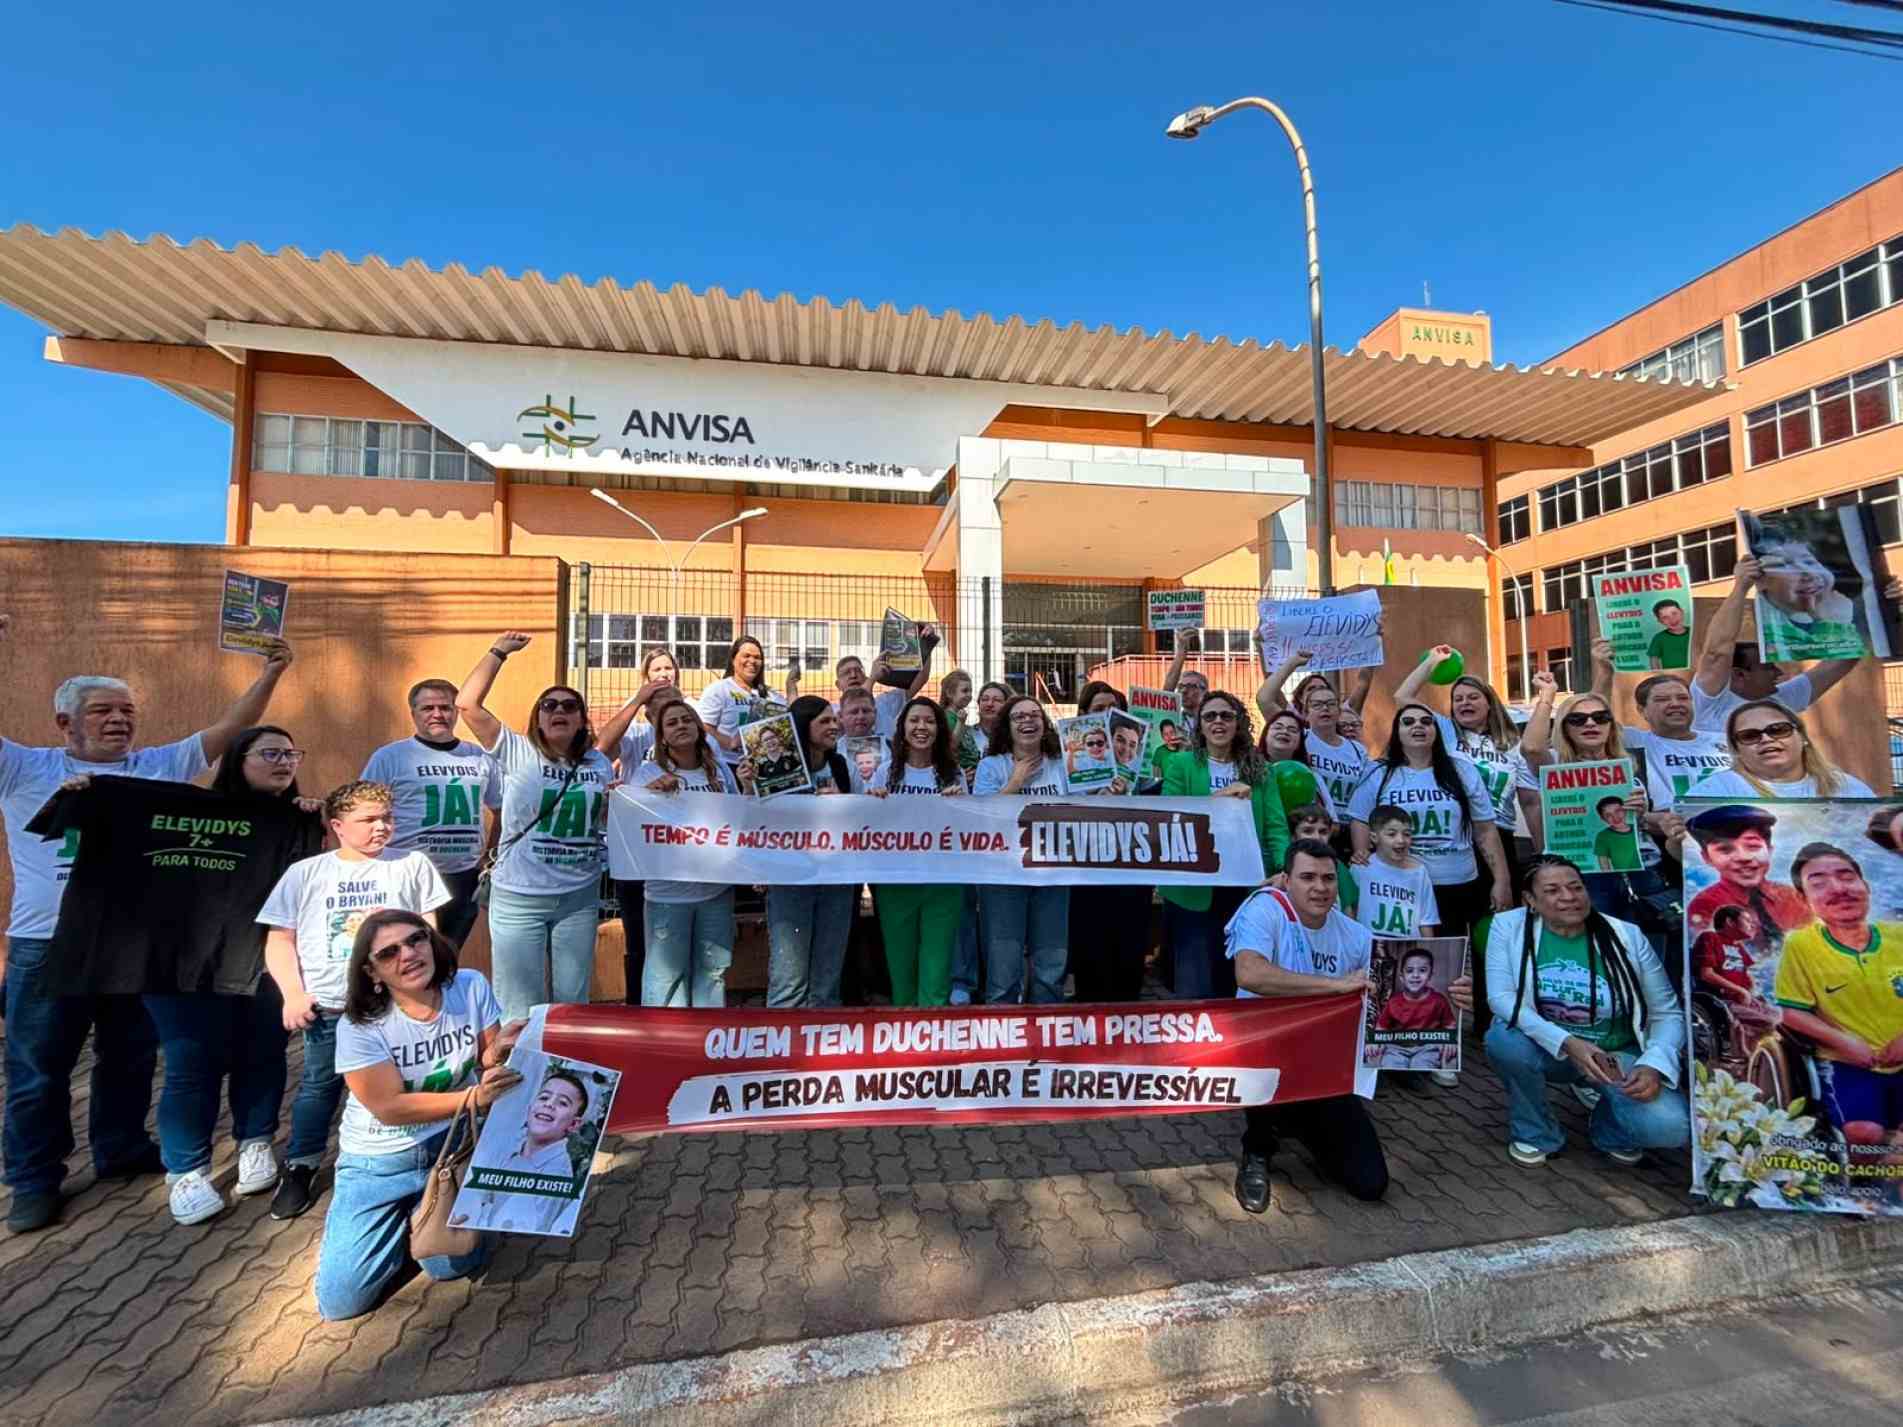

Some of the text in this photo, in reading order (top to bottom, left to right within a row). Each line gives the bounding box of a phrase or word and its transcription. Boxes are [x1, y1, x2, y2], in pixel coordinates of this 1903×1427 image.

[1412, 326, 1474, 346] ANVISA
[621, 409, 756, 445] ANVISA
[620, 447, 682, 464] Agência
[687, 451, 749, 468] Nacional
[753, 454, 770, 468] de
[775, 456, 841, 474] Vigilância
[1601, 571, 1683, 596] ANVISA
[1151, 591, 1203, 604] DUCHENNE
[1132, 689, 1178, 711] ANVISA
[1547, 764, 1627, 790] ANVISA
[421, 777, 481, 827] JÁ!
[151, 814, 252, 837] ELEVIDYS
[189, 833, 214, 848] 7+
[641, 823, 1009, 852] TEMPO É MÚSCULO. MÚSCULO É VIDA.
[1031, 813, 1200, 864] ELEVIDYS JÁ!
[152, 854, 237, 871] PARA TODOS
[337, 880, 379, 894] SALVE
[326, 896, 336, 909] O
[1371, 901, 1414, 936] JÁ!
[391, 1024, 476, 1068] ELEVIDYS
[704, 1013, 1224, 1060] QUEM TEM DUCHENNE TEM PRESSA.
[1374, 1031, 1451, 1041] MEU FILHO EXISTE!
[709, 1060, 1242, 1114] A PERDA MUSCULAR É IRREVESSÍVEL
[1768, 1133, 1827, 1151] obrigado
[1829, 1142, 1847, 1153] ao
[1817, 1160, 1841, 1175] DO
[477, 1172, 573, 1193] MEU FILHO EXISTE!
